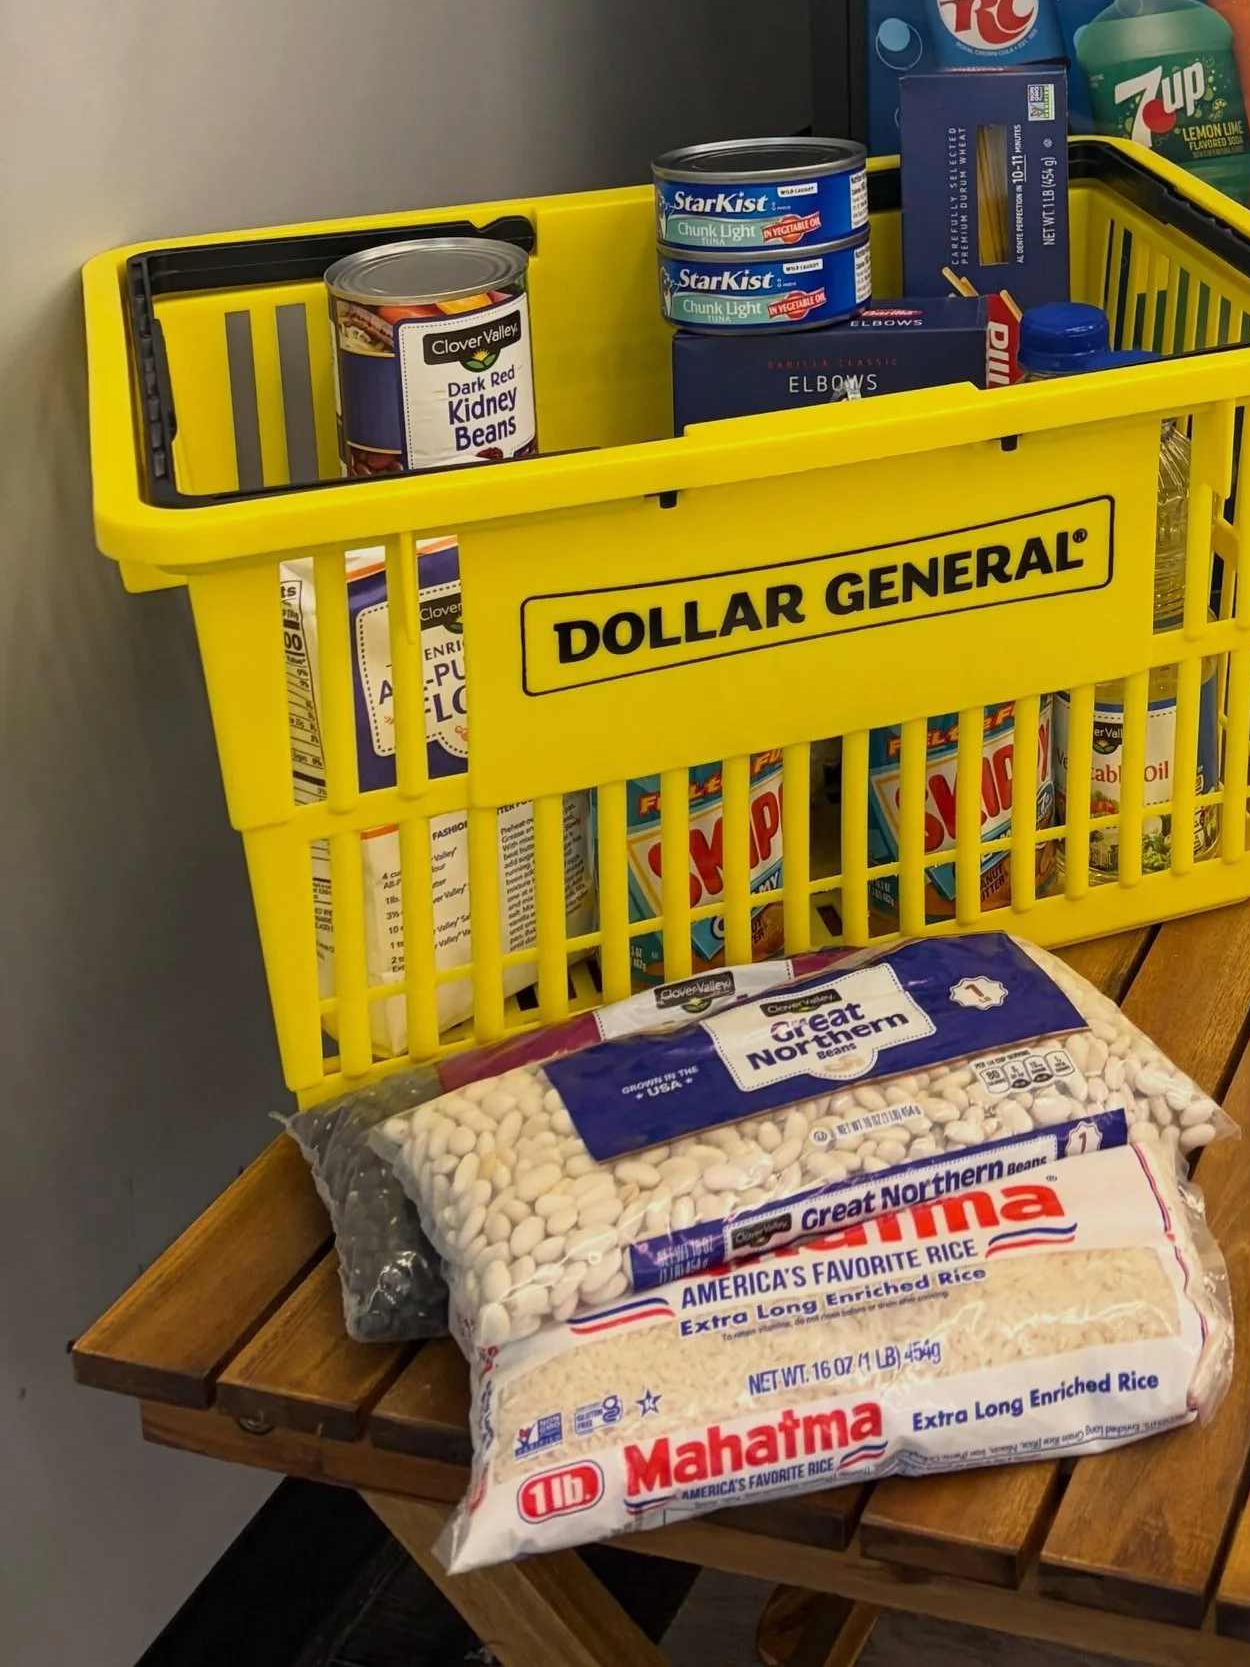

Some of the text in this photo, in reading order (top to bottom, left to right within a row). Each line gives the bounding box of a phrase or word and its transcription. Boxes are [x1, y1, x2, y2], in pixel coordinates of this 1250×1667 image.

[1182, 121, 1244, 142] LEMON LIME
[673, 191, 769, 213] StarKist
[678, 222, 756, 241] Chunk Light
[763, 216, 821, 238] IN VEGETABLE OIL
[678, 268, 775, 291] StarKist
[683, 299, 762, 318] Chunk Light
[850, 319, 922, 327] ELBOWS
[431, 322, 518, 355] Clover Valley
[447, 364, 516, 398] Dark Red
[789, 374, 877, 393] ELBOWS
[448, 386, 518, 425] Kidney
[455, 415, 517, 451] Beans
[552, 531, 1085, 664] DOLLAR GENERAL
[770, 1003, 865, 1044] Great
[745, 1012, 909, 1070] Northern
[816, 1042, 857, 1060] Beans
[801, 1155, 1047, 1231] Great Northern Beans
[681, 1239, 978, 1309] AMERICA'S FAVORITE RICE
[913, 1371, 1159, 1433] Extra Long Enriched Rice
[624, 1401, 883, 1498] Mahatma
